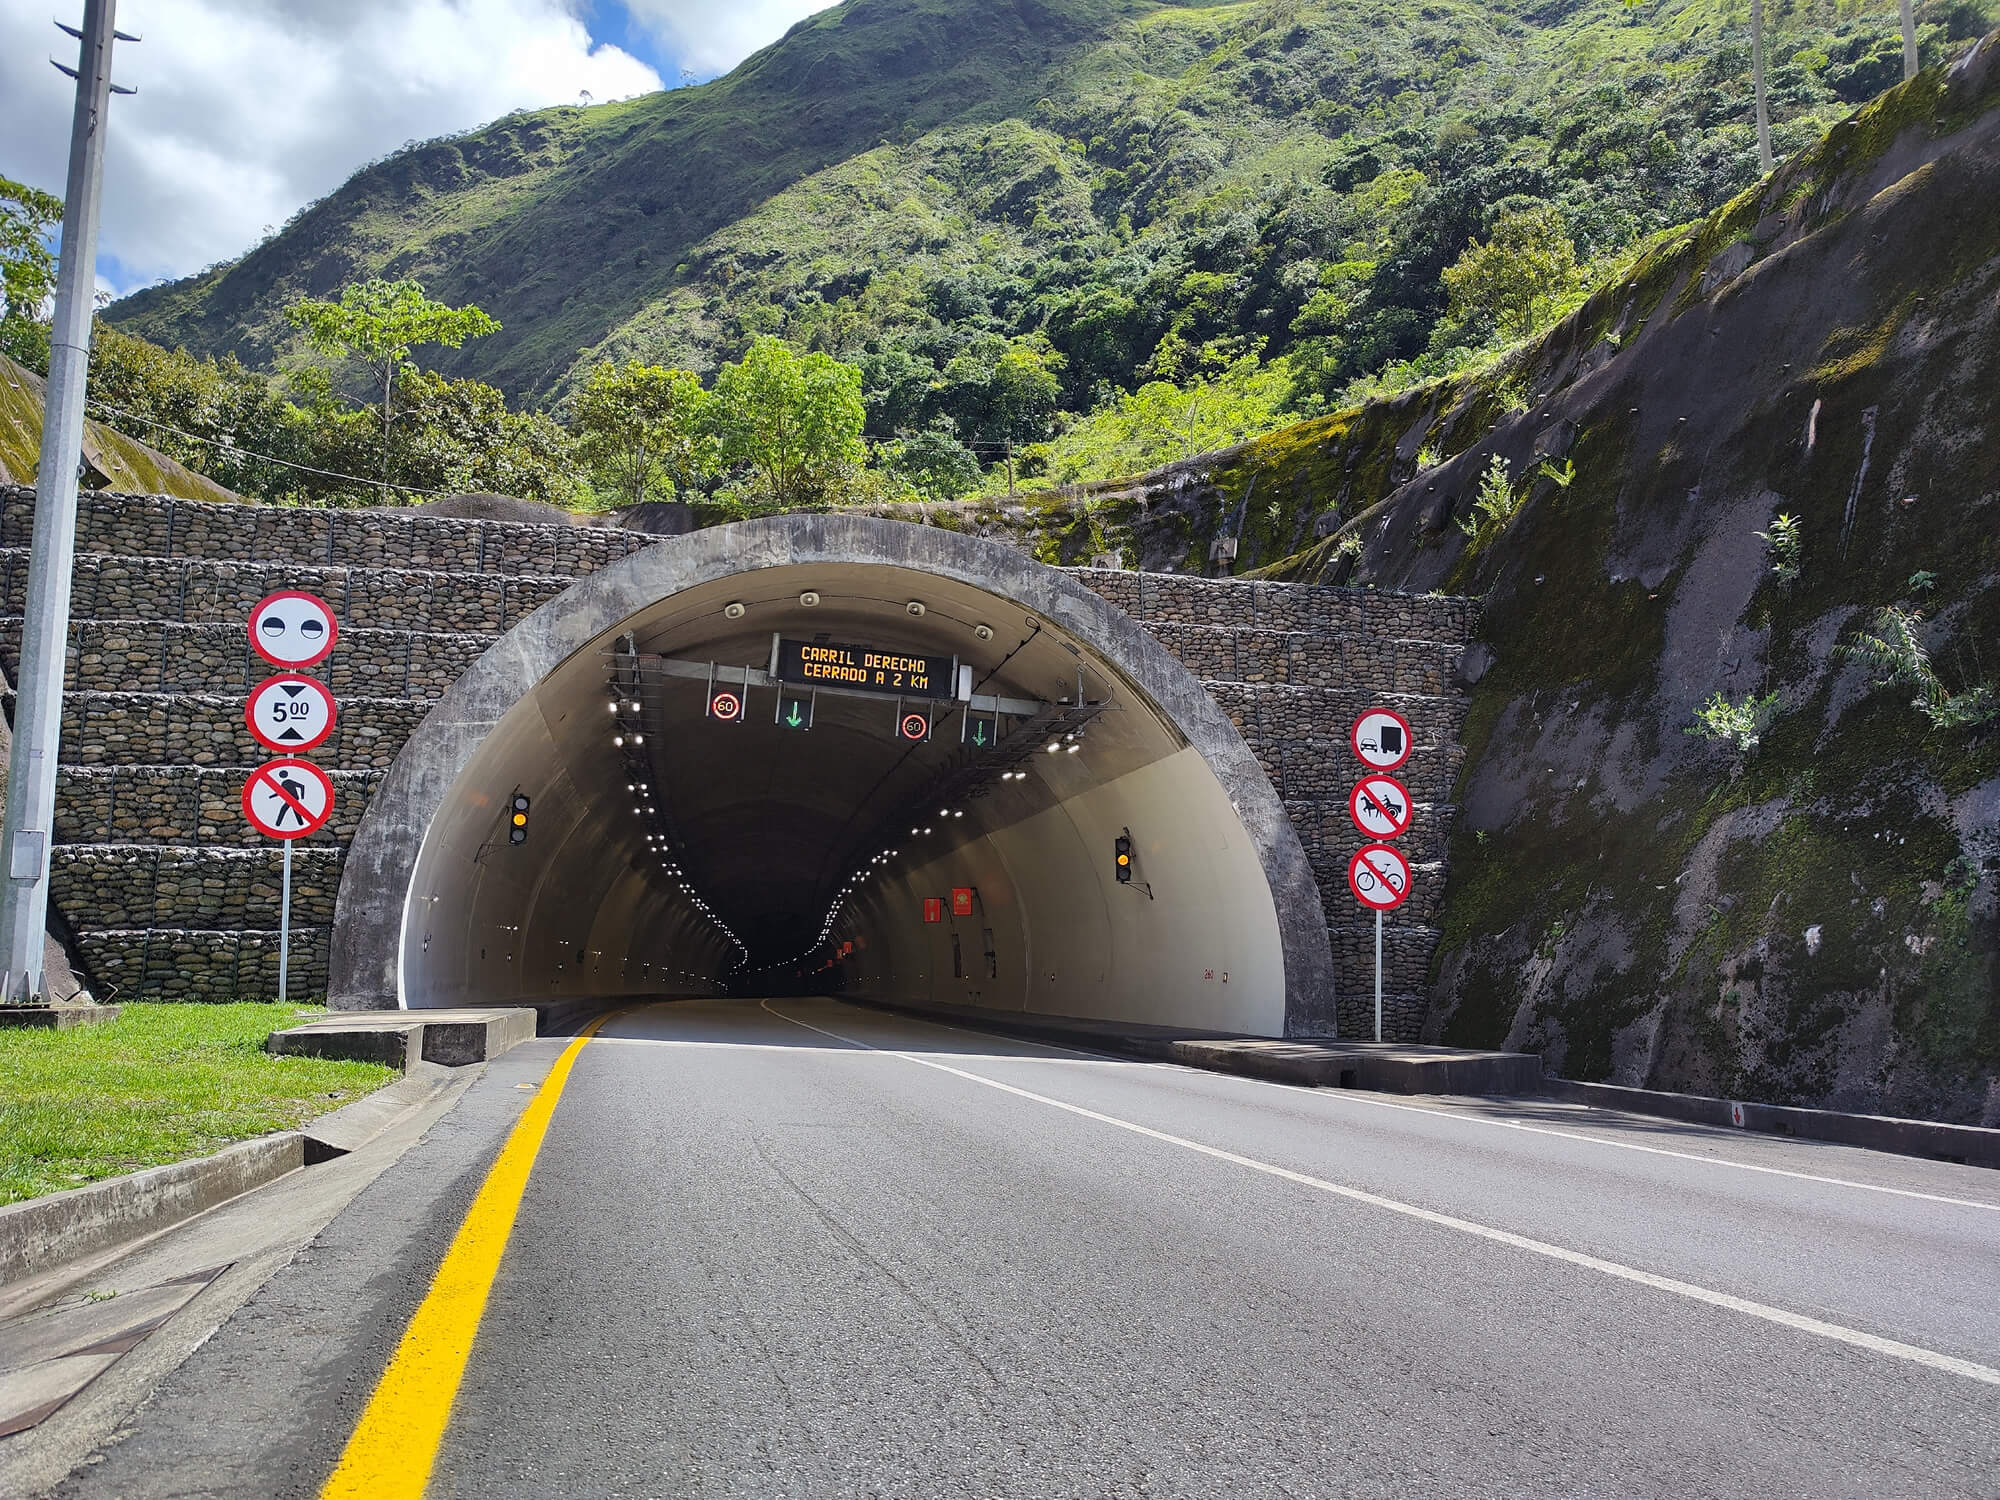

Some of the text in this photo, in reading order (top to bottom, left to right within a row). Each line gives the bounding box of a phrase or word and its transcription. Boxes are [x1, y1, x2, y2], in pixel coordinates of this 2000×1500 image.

[801, 646, 926, 673] CARRIL DERECHO
[804, 662, 929, 690] CERRADO A 2 KM
[717, 700, 733, 712] 60
[906, 721, 921, 732] 60
